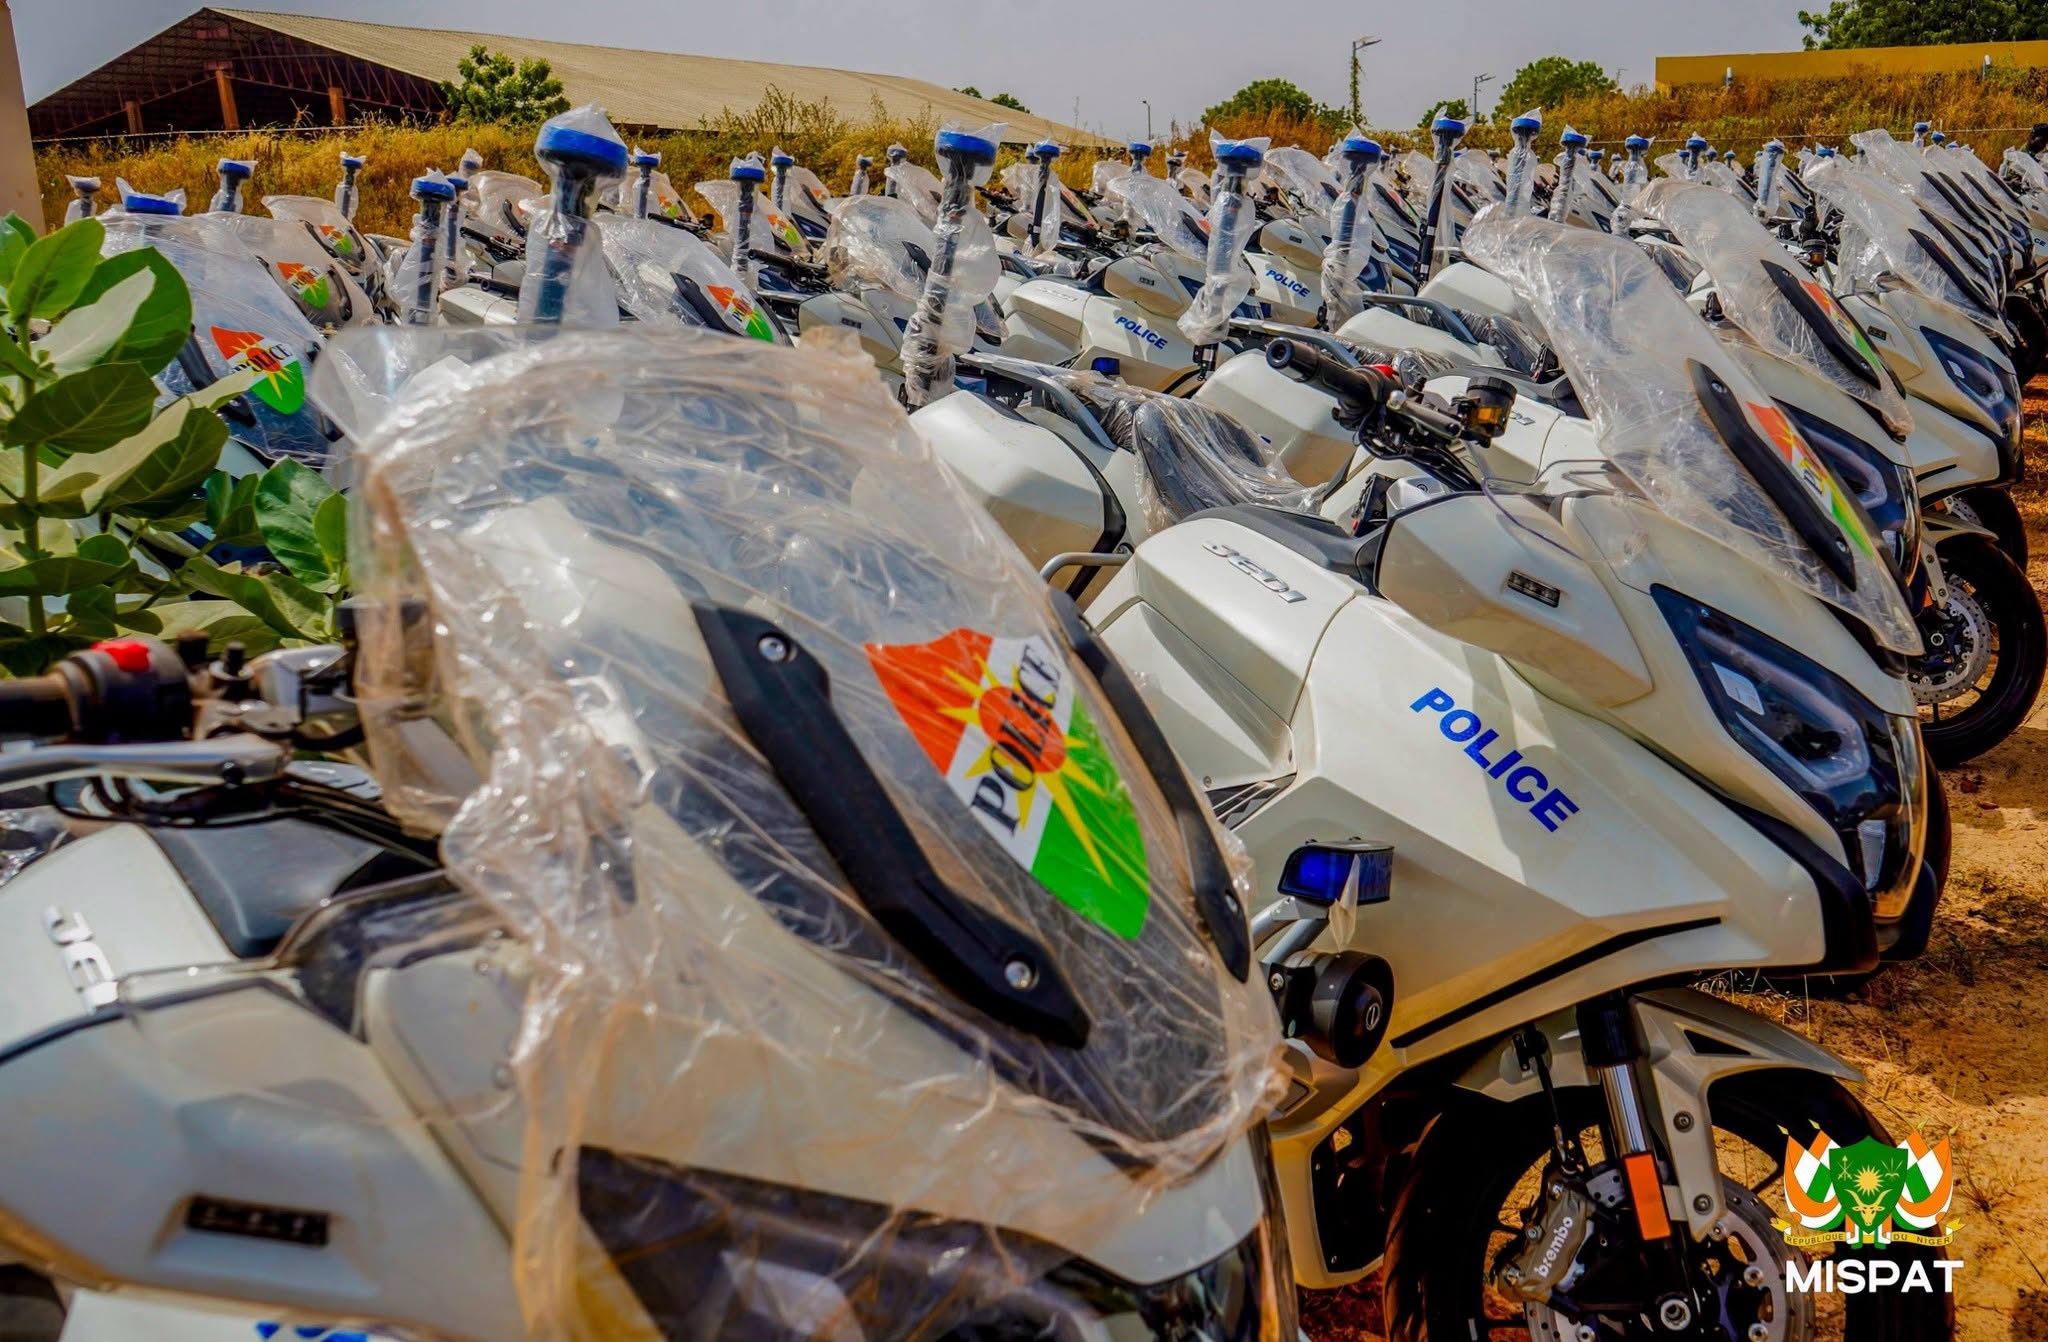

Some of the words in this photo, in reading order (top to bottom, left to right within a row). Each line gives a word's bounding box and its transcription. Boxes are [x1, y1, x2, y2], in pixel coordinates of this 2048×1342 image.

[1265, 269, 1311, 298] POLICE
[1114, 316, 1168, 350] POLICE
[969, 644, 1061, 838] POLICE
[1409, 687, 1580, 833] POLICE
[1533, 1216, 1574, 1278] brembo
